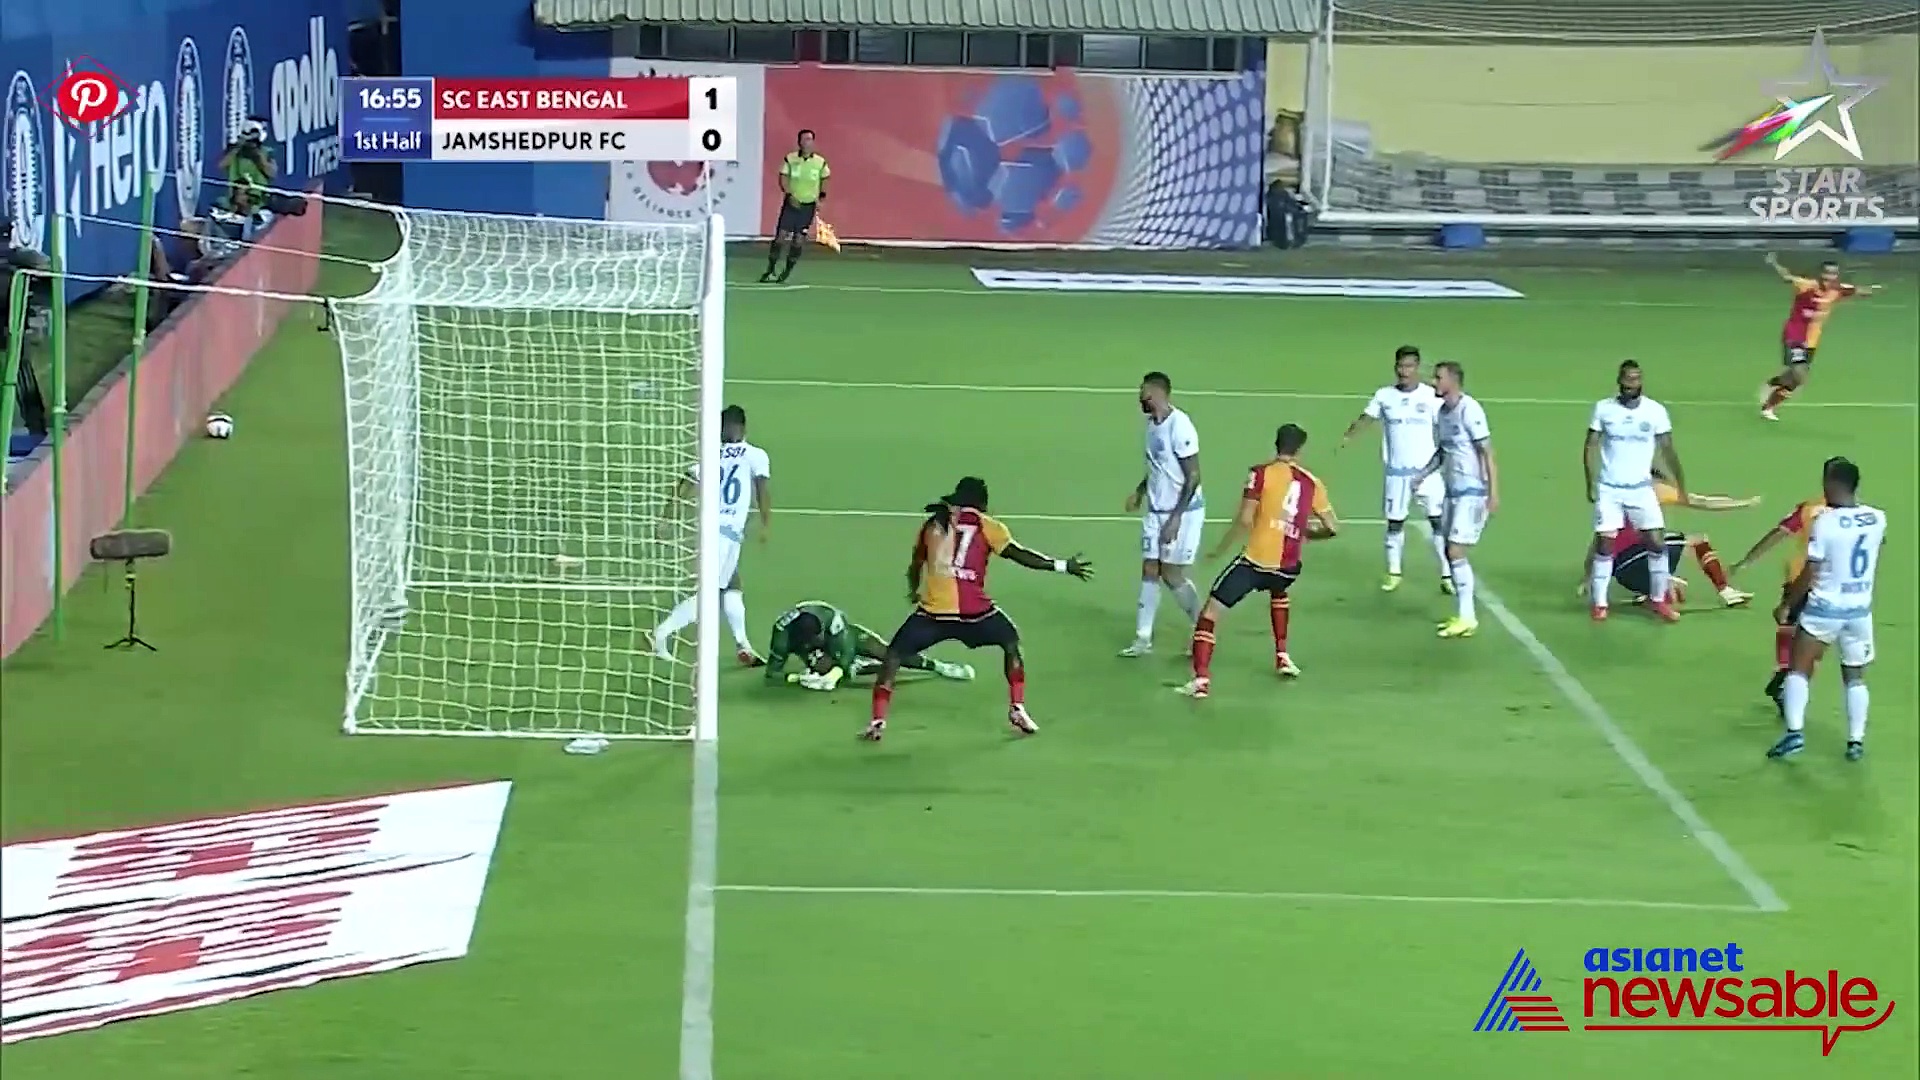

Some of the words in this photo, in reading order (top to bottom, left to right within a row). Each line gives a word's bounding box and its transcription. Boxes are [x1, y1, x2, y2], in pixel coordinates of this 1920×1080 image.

[271, 16, 338, 175] apollo
[89, 80, 168, 216] Hero
[720, 463, 741, 506] 6
[1282, 480, 1302, 520] 4
[1849, 533, 1869, 578] 6
